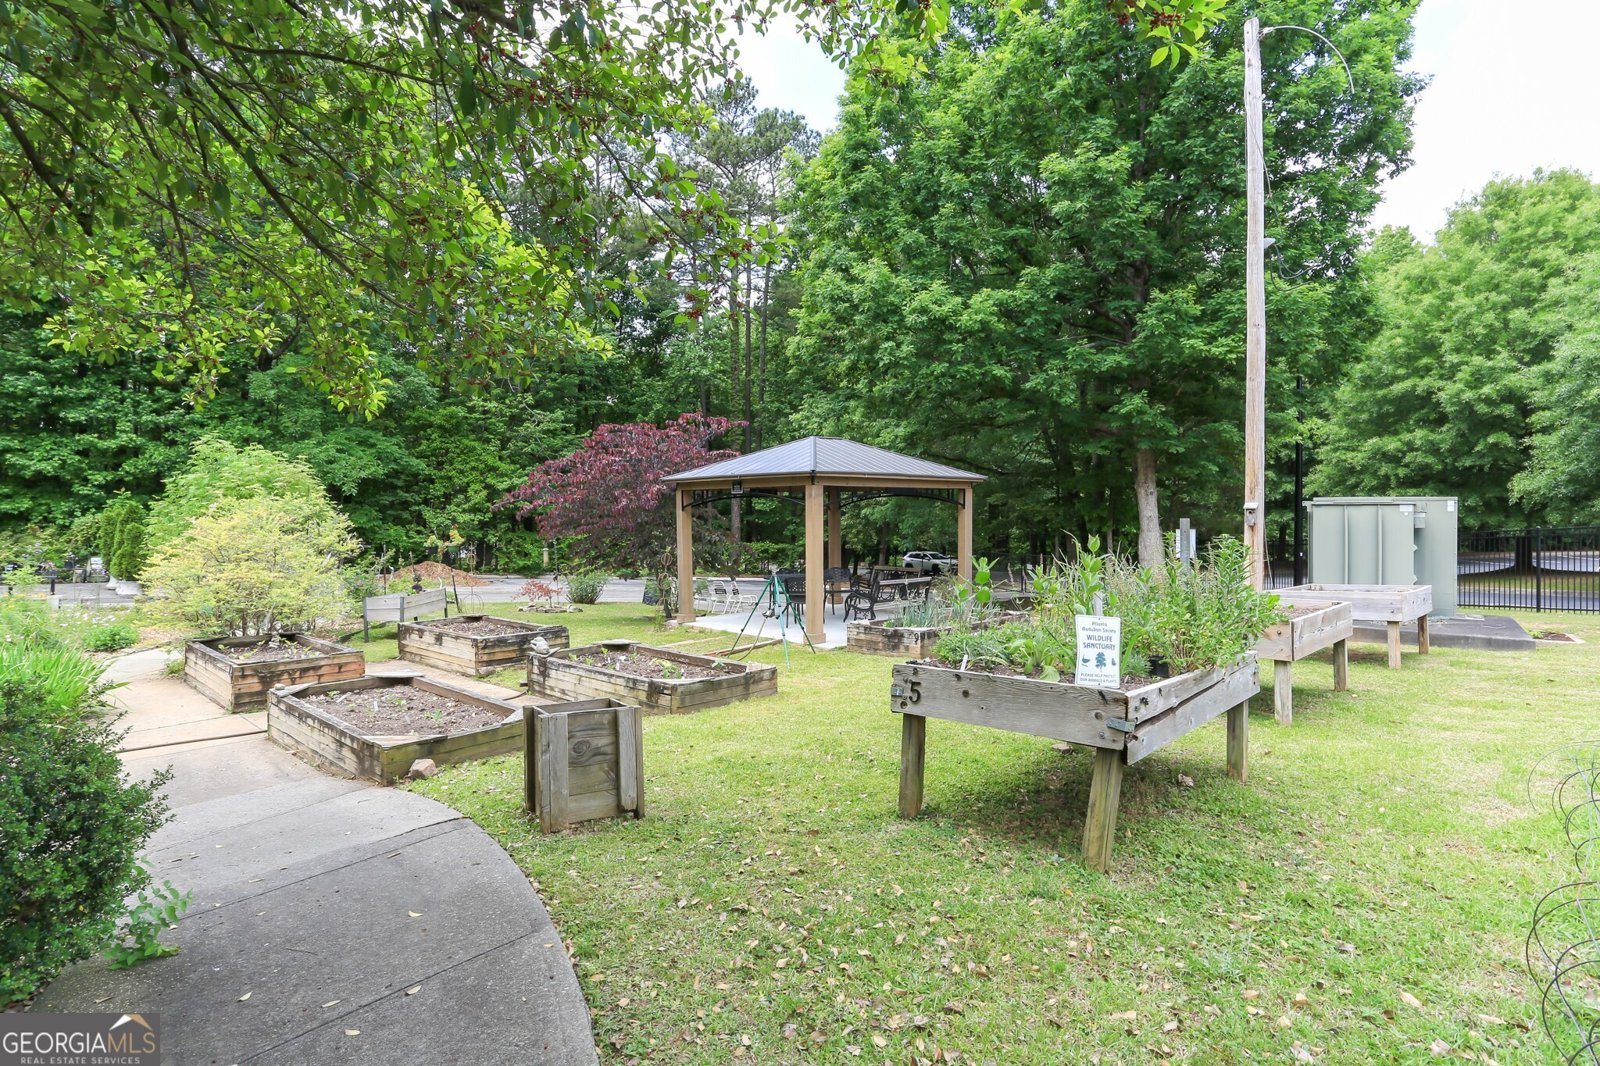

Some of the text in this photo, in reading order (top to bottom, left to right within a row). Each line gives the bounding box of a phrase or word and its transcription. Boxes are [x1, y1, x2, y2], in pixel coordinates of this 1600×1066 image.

[914, 632, 919, 644] 9
[1086, 634, 1113, 643] WILDLIFE
[1083, 642, 1116, 650] SANCTUARY
[908, 681, 921, 703] 5
